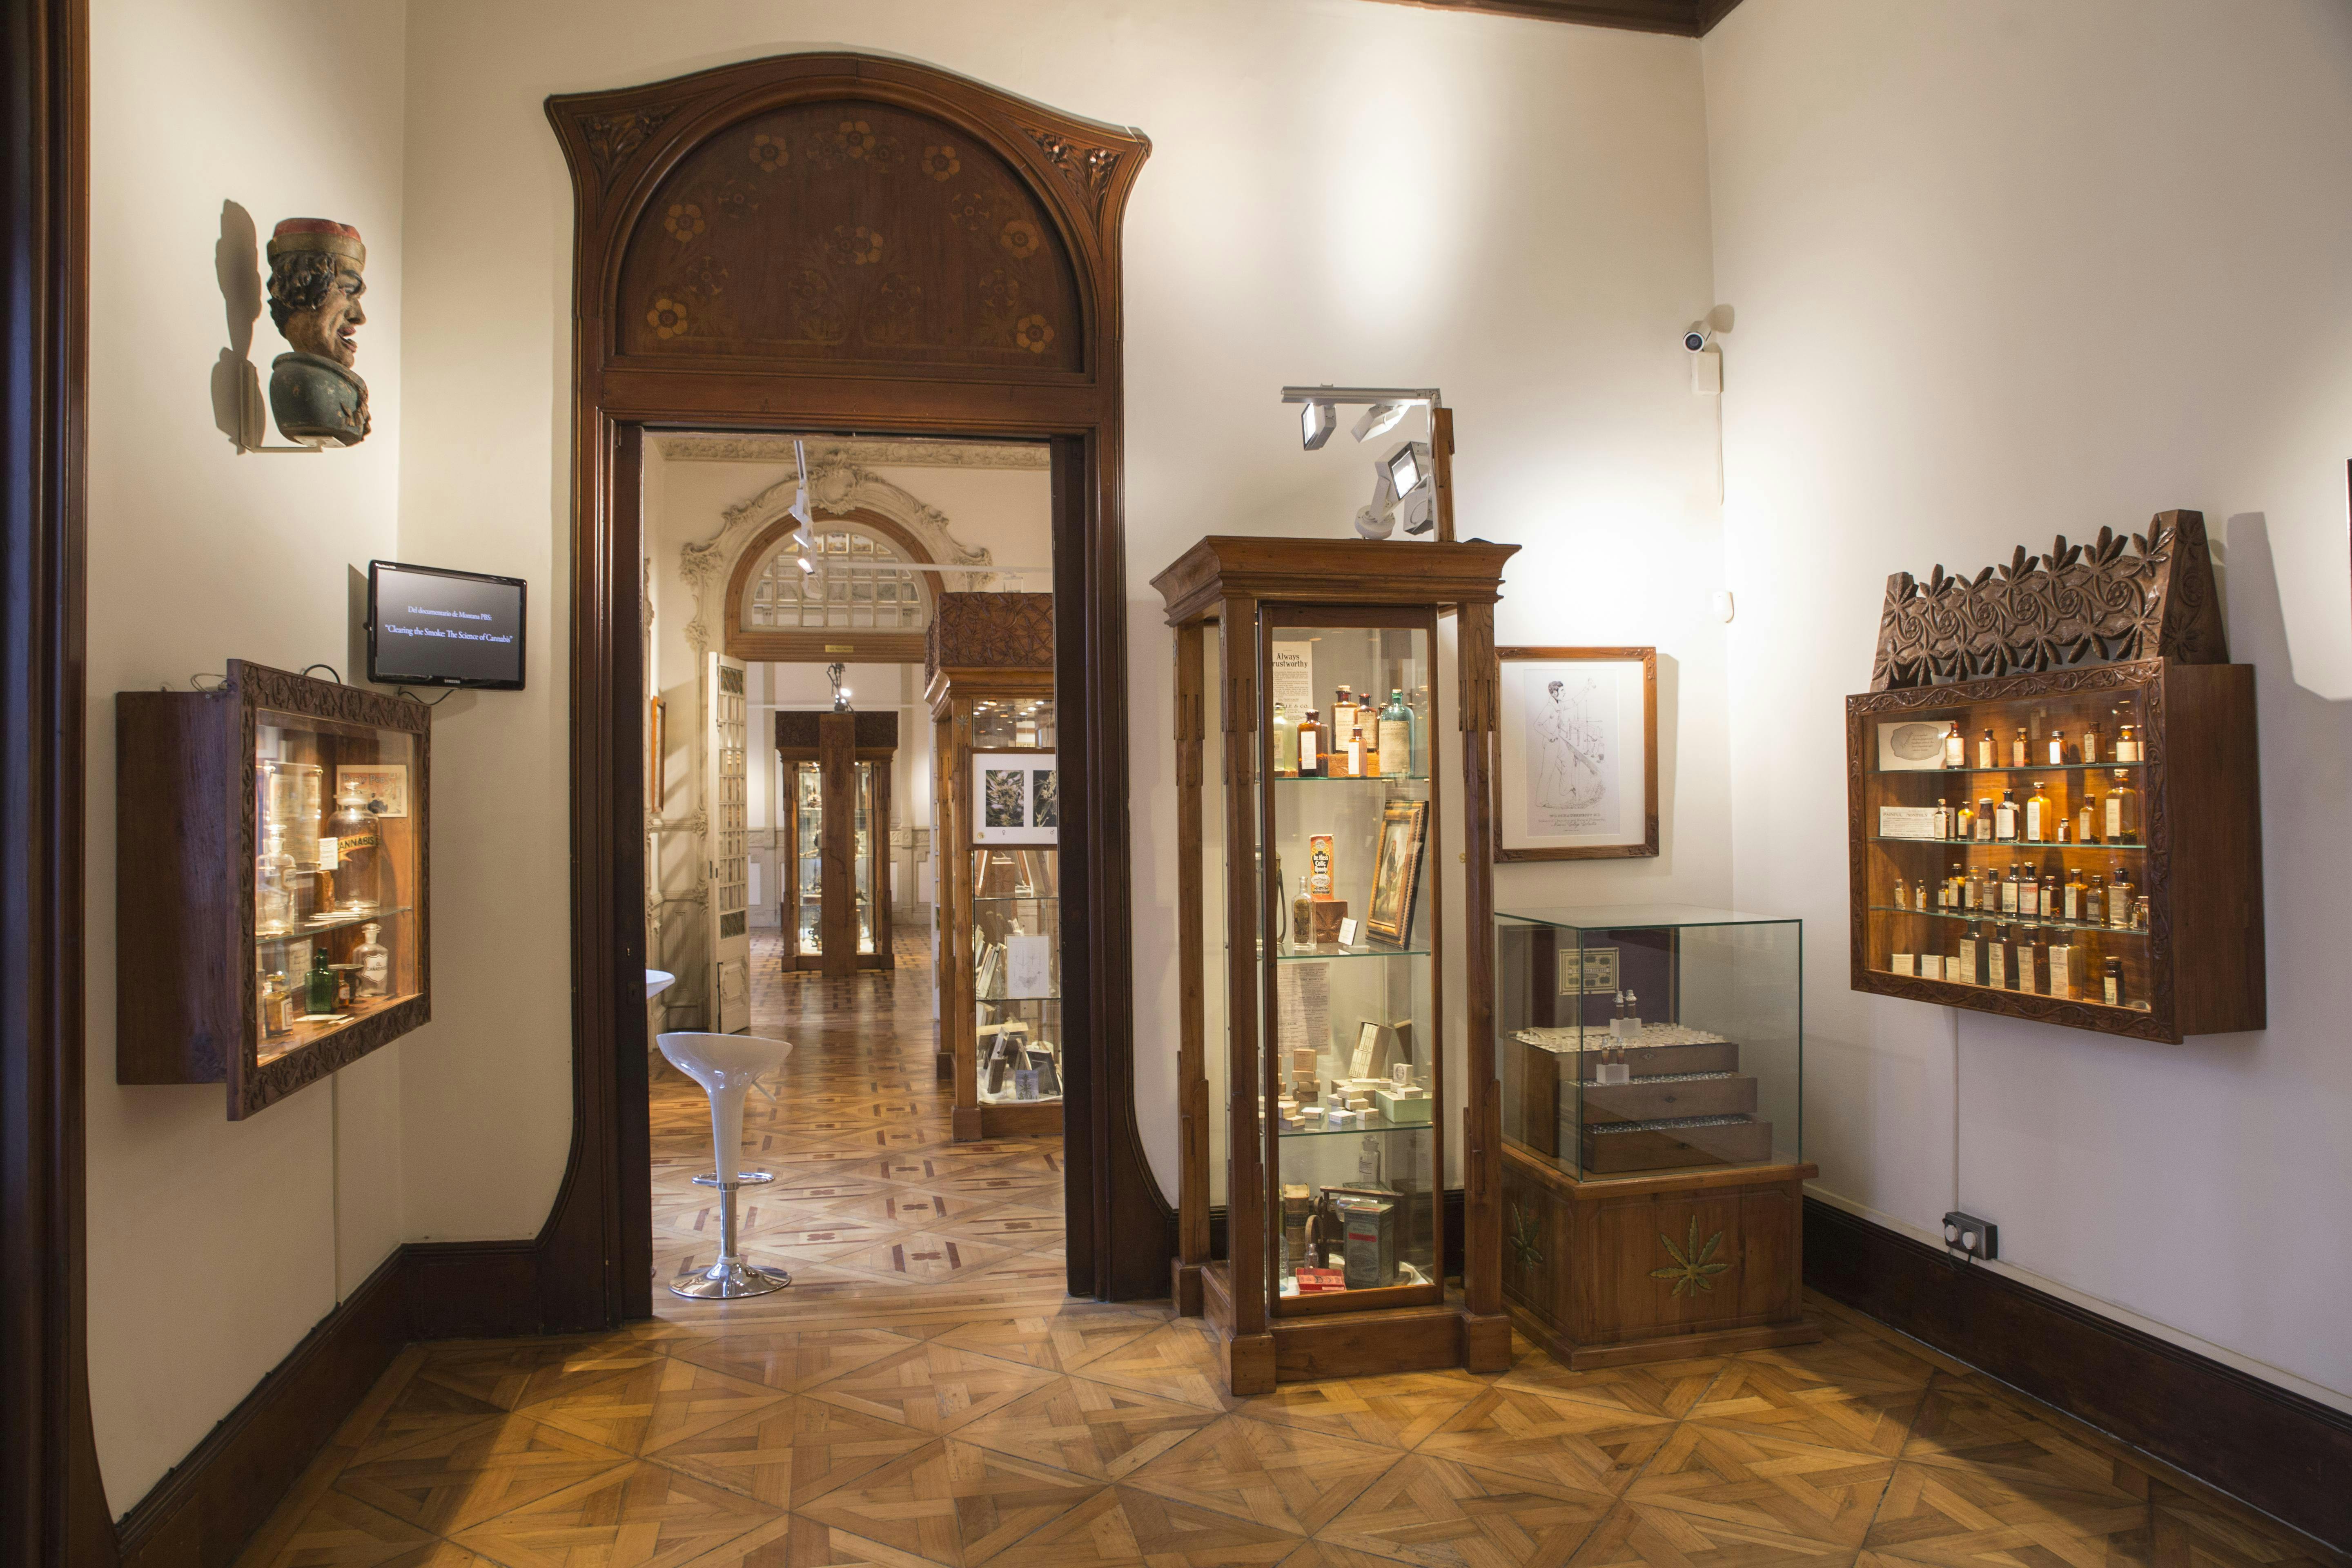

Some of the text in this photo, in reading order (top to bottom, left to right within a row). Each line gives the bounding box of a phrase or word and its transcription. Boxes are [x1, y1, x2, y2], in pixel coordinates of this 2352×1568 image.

[419, 607, 451, 617] documentario
[459, 611, 479, 620] Montana
[414, 627, 423, 636] the
[425, 628, 445, 637] Smoke:
[447, 630, 457, 638] The
[459, 631, 478, 640] Science
